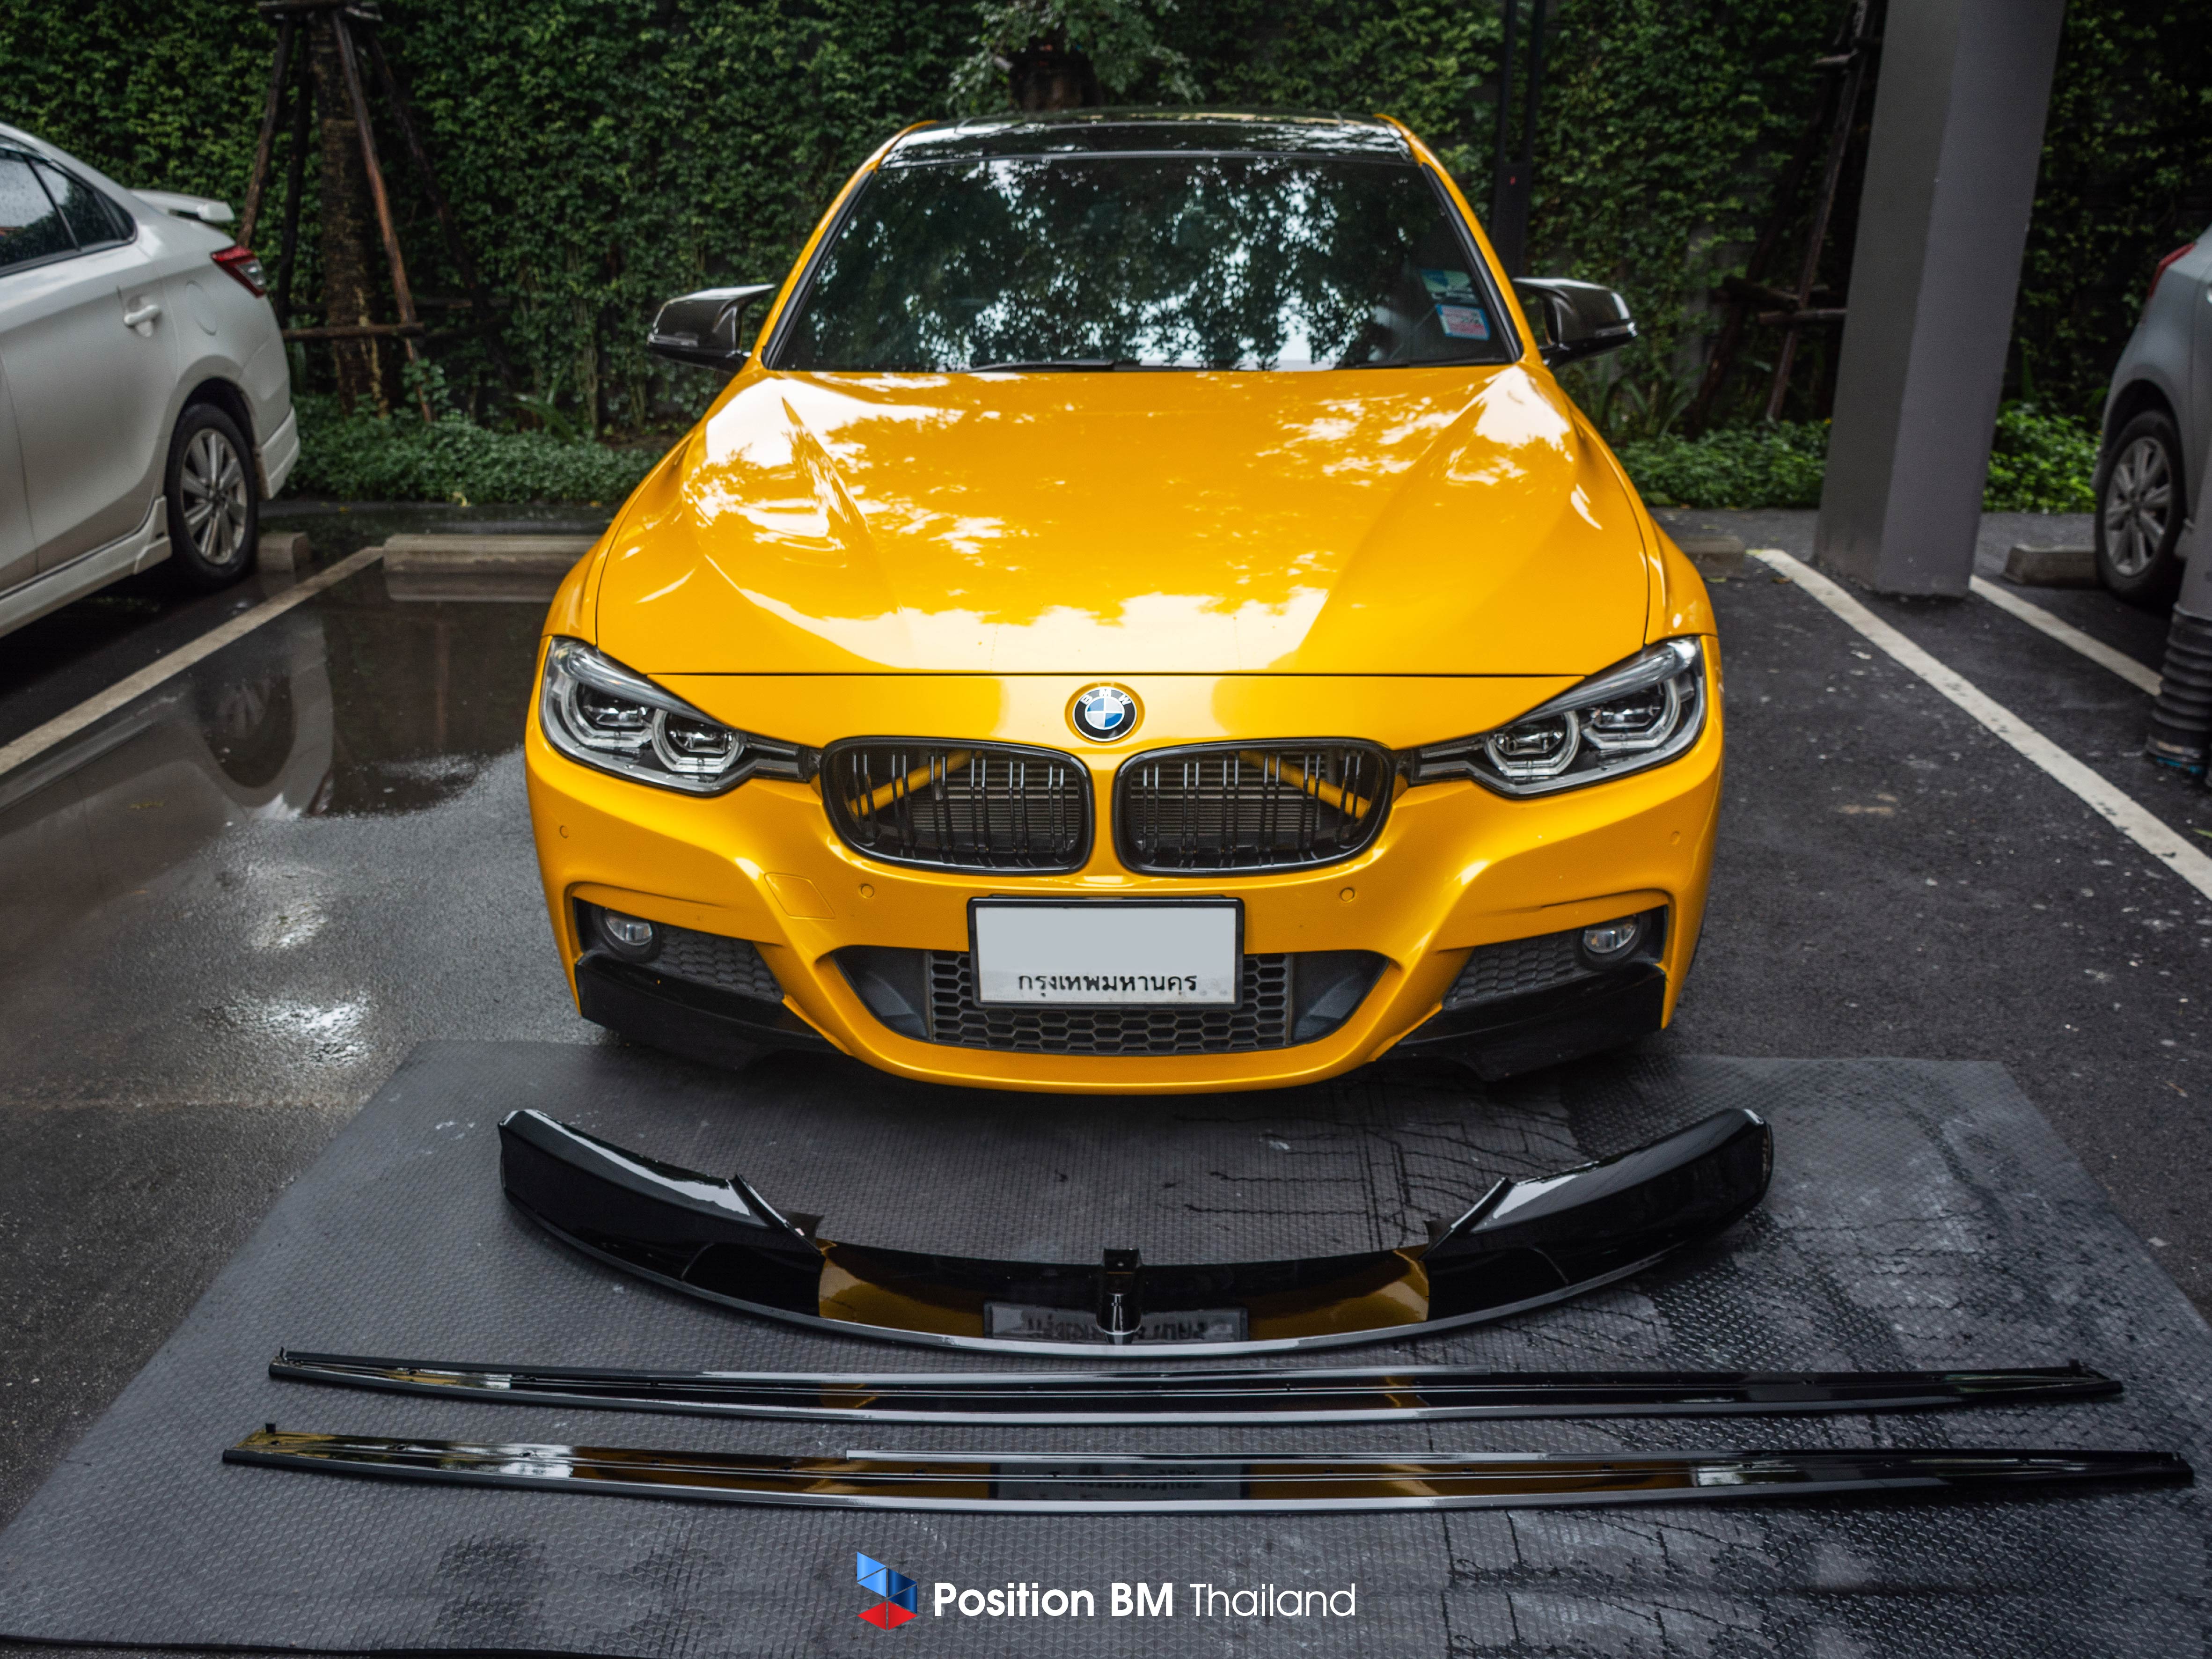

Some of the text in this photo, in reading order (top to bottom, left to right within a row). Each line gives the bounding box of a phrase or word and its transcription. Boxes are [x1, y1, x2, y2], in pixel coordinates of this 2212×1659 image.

[1080, 689, 1131, 705] BMW
[1018, 975, 1197, 997] กรุงเทพมหานคร
